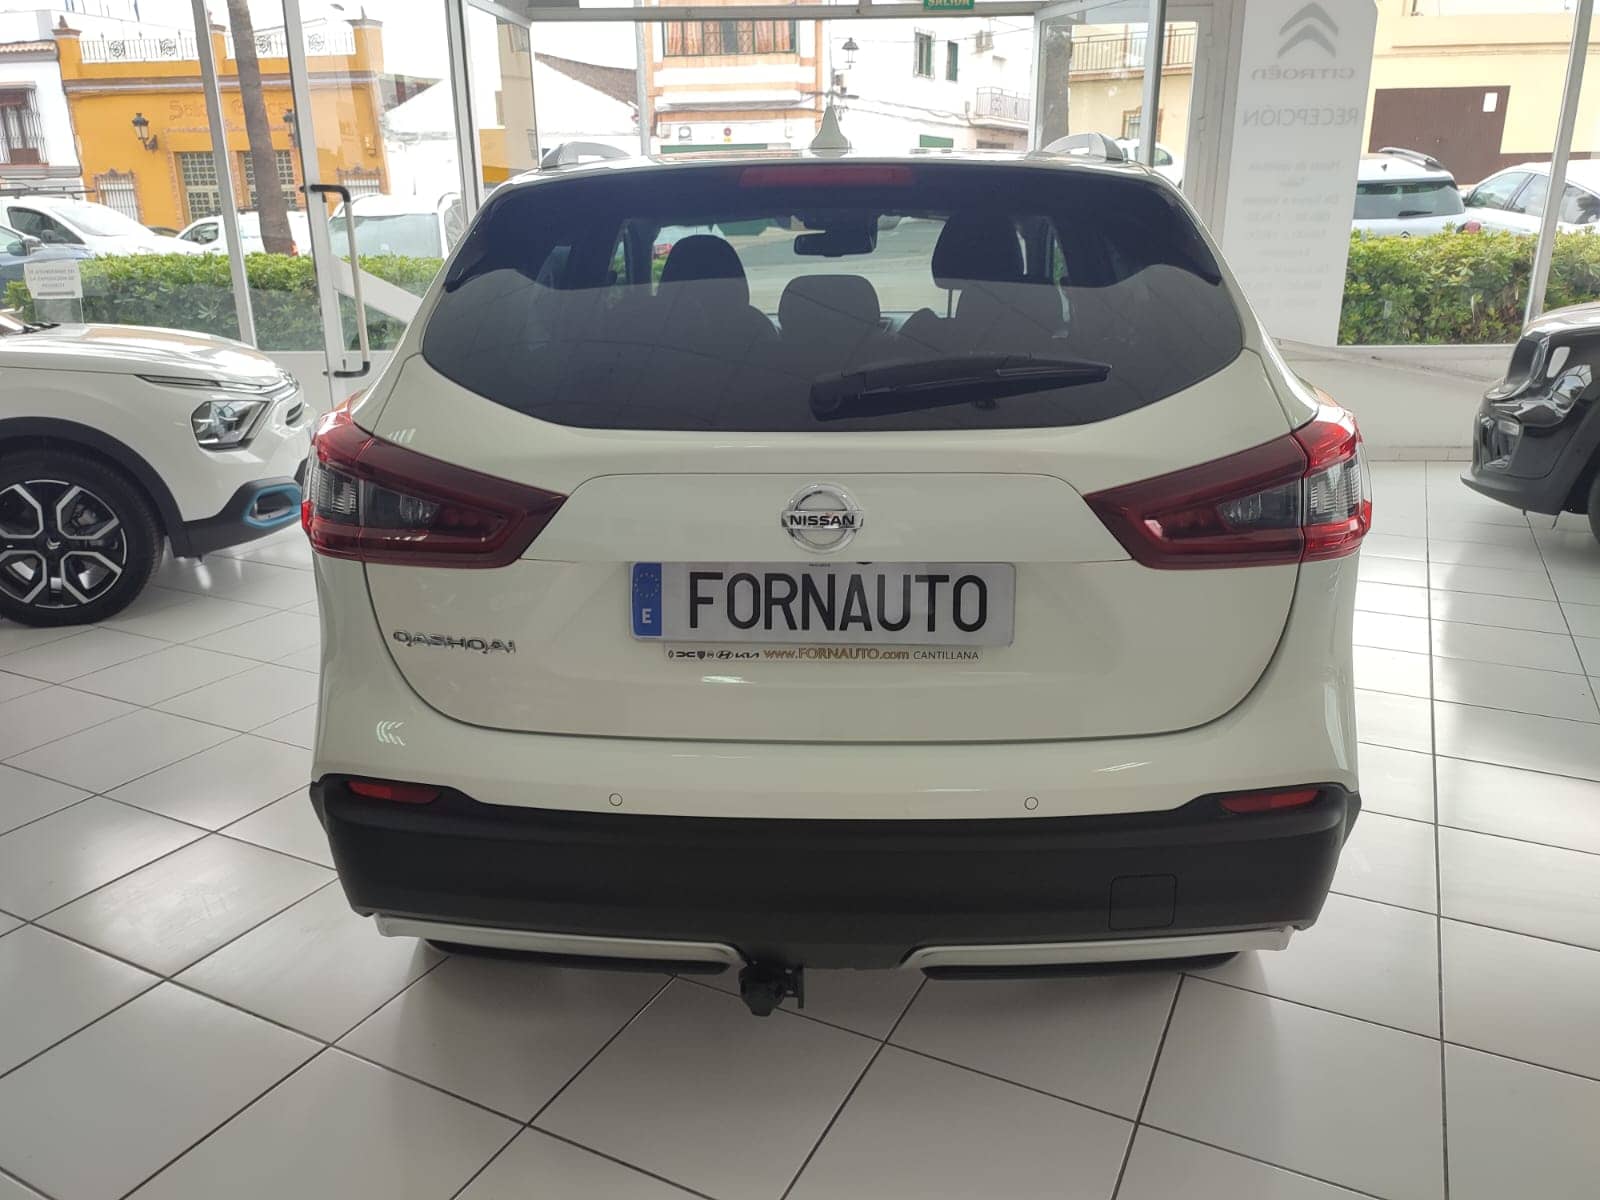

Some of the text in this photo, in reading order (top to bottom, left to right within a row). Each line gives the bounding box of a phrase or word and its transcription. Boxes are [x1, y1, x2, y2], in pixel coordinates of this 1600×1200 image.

[789, 514, 856, 527] NISSAN
[689, 571, 988, 633] FORNAUTO
[641, 607, 653, 624] E
[393, 631, 516, 654] QASHQAI
[763, 647, 910, 660] www.FORNAUTO.com
[913, 650, 979, 660] CANTILLANA
